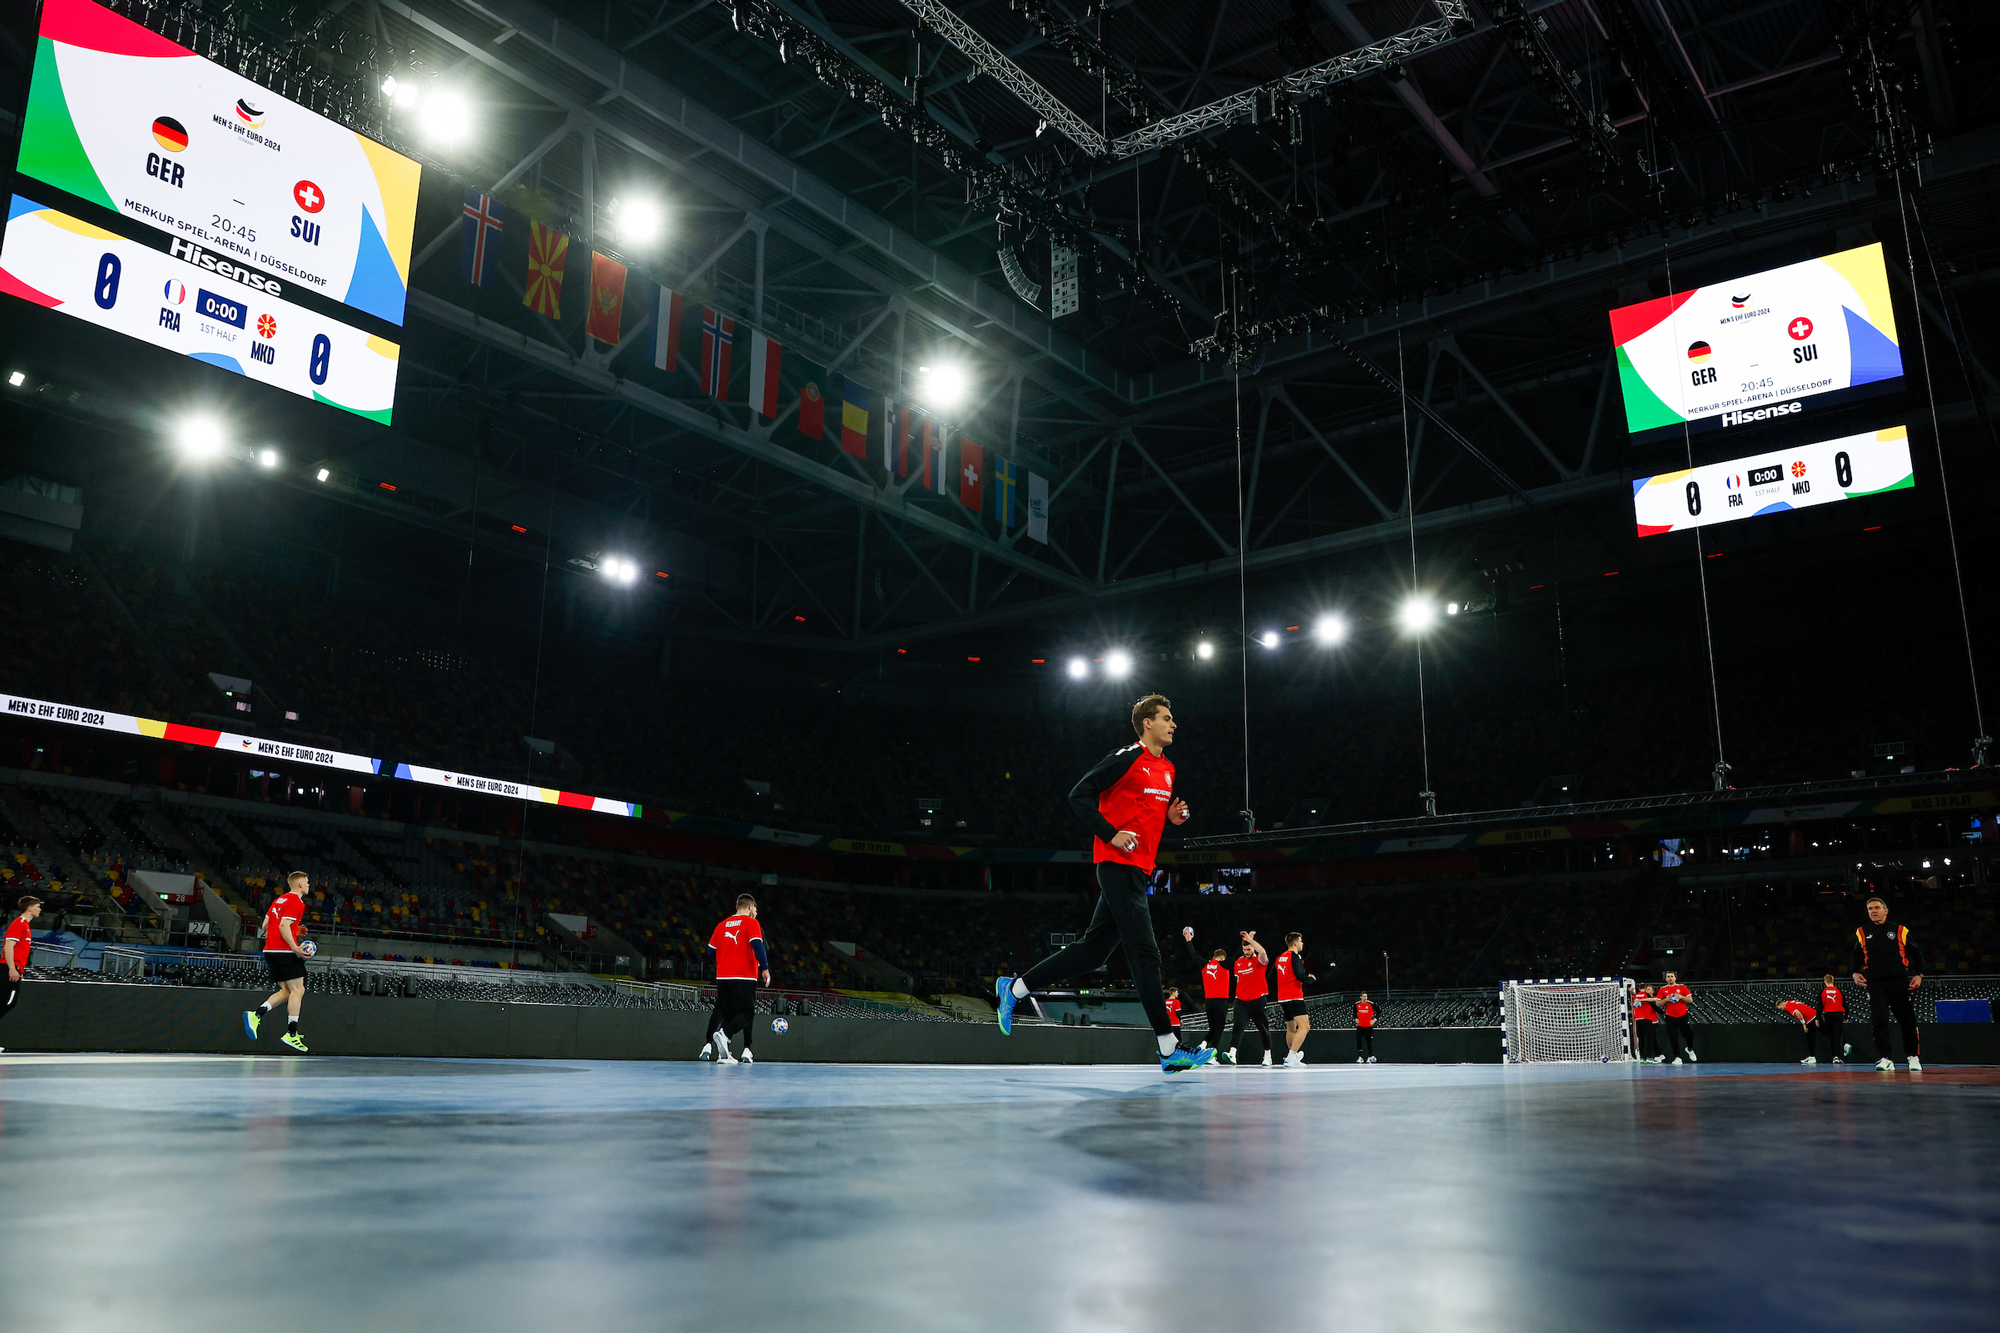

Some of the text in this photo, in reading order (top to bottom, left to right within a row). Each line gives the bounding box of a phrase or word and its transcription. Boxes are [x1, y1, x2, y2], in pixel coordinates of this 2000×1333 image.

[213, 114, 281, 152] MENS EHF EURO 2024
[146, 152, 185, 188] GER
[212, 214, 256, 242] 20:45
[290, 215, 320, 246] SUI
[124, 198, 174, 226] MERKUR
[177, 220, 250, 257] SPIEL-ARENA
[260, 254, 327, 287] DÜSSELDORF
[170, 237, 282, 296] Hisense
[94, 253, 121, 310] 0
[159, 307, 180, 332] FRA
[206, 298, 238, 321] 0:00
[1744, 311, 1756, 319] EURO
[1757, 308, 1770, 316] 2024
[200, 323, 237, 342] 1ST HALF
[250, 340, 275, 365] MKD
[310, 333, 331, 385] 0
[1793, 344, 1818, 364] SUI
[1692, 367, 1718, 386] GER
[1740, 377, 1774, 392] 20:45
[1688, 403, 1720, 414] MERKUR
[1722, 392, 1774, 408] SPIEL-ARENA
[1780, 378, 1833, 396] DÜSSELDORF
[1722, 402, 1802, 428] Hisense
[1754, 469, 1777, 483] 0:00
[1835, 452, 1852, 488] 0
[1686, 481, 1701, 516] 0
[1766, 486, 1780, 494] HALF
[1792, 480, 1810, 496] MKD
[1728, 494, 1743, 507] FRA
[38, 704, 55, 717] EHF
[57, 707, 79, 721] EURO
[81, 712, 104, 726] 2024
[258, 742, 333, 764] MENS EHF EURO 2024
[476, 780, 486, 789] EHF
[488, 781, 502, 792] EURO
[504, 784, 518, 795] 2024
[1910, 794, 1972, 809] HERE TO PLAY
[193, 923, 206, 933] 27
